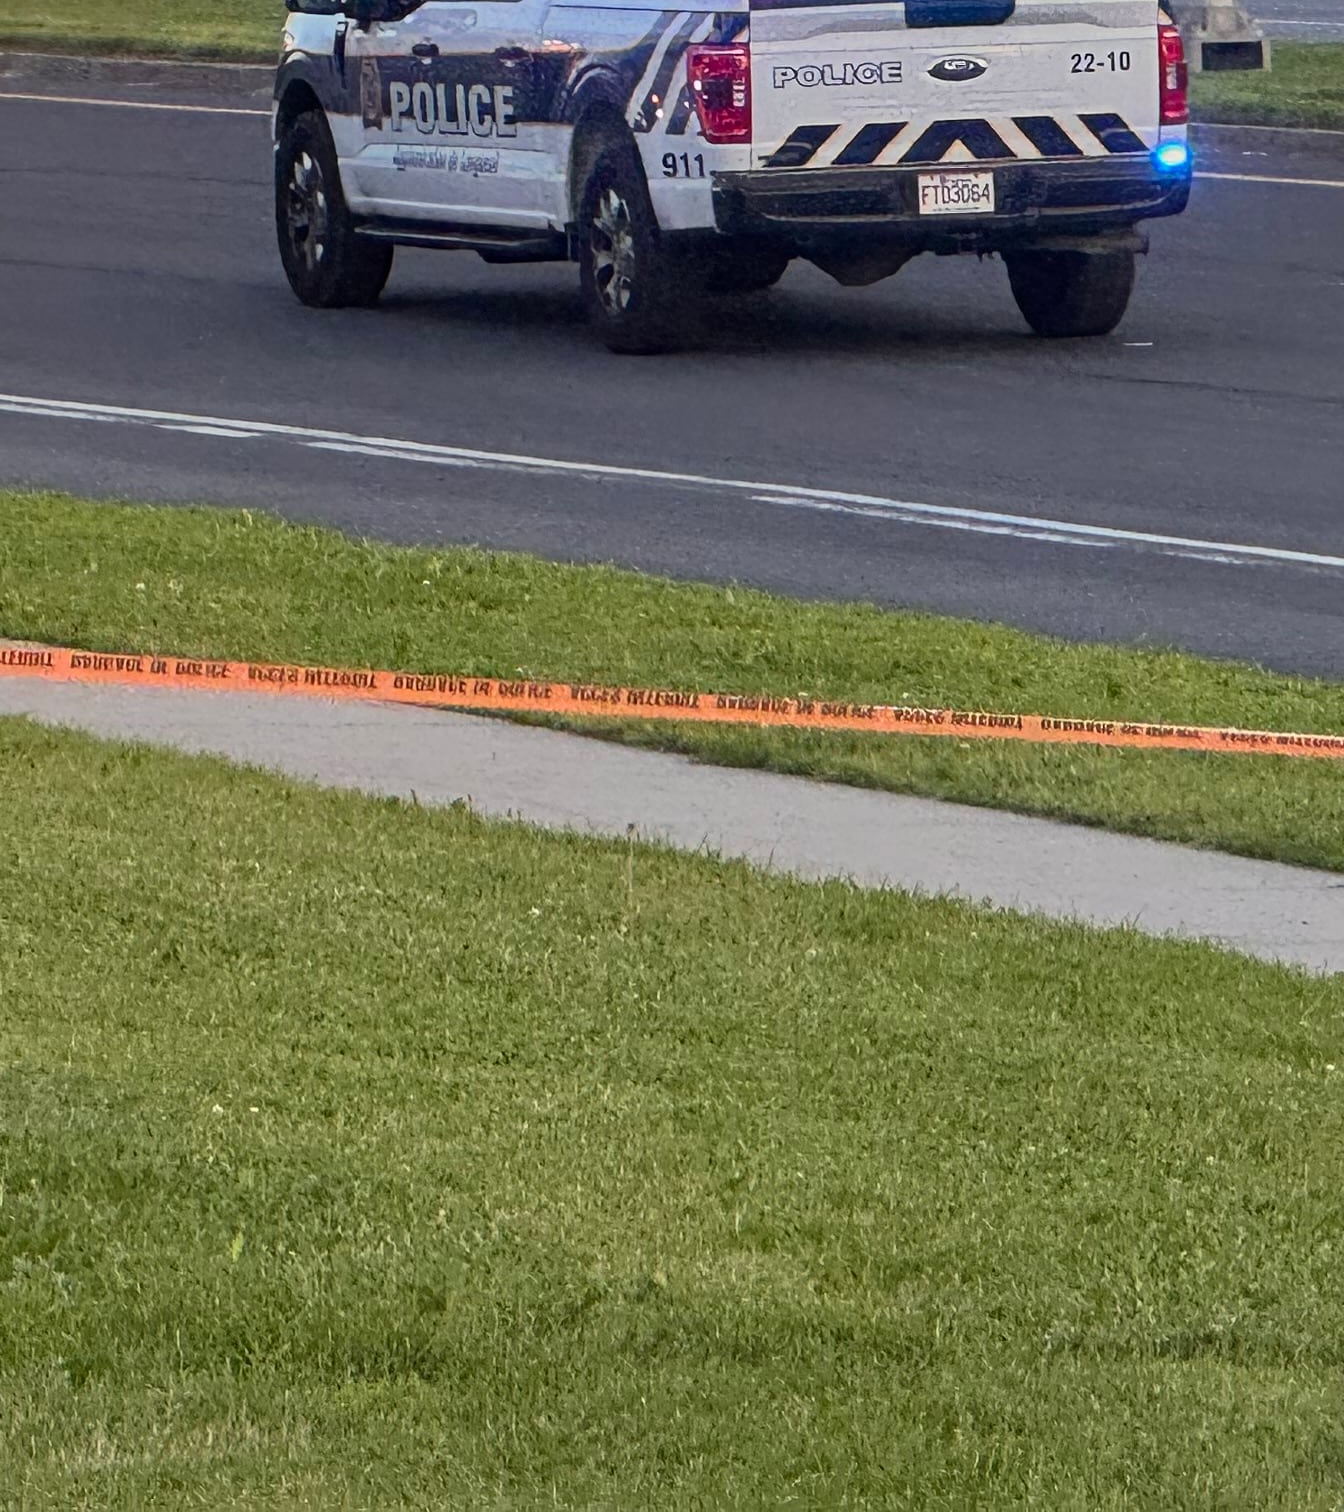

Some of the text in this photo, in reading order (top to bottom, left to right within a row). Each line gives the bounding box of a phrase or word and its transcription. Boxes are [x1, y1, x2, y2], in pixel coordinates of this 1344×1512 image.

[773, 61, 903, 88] POLICE
[1070, 51, 1130, 74] 22-10
[389, 81, 518, 138] POLICE
[661, 152, 706, 178] 911
